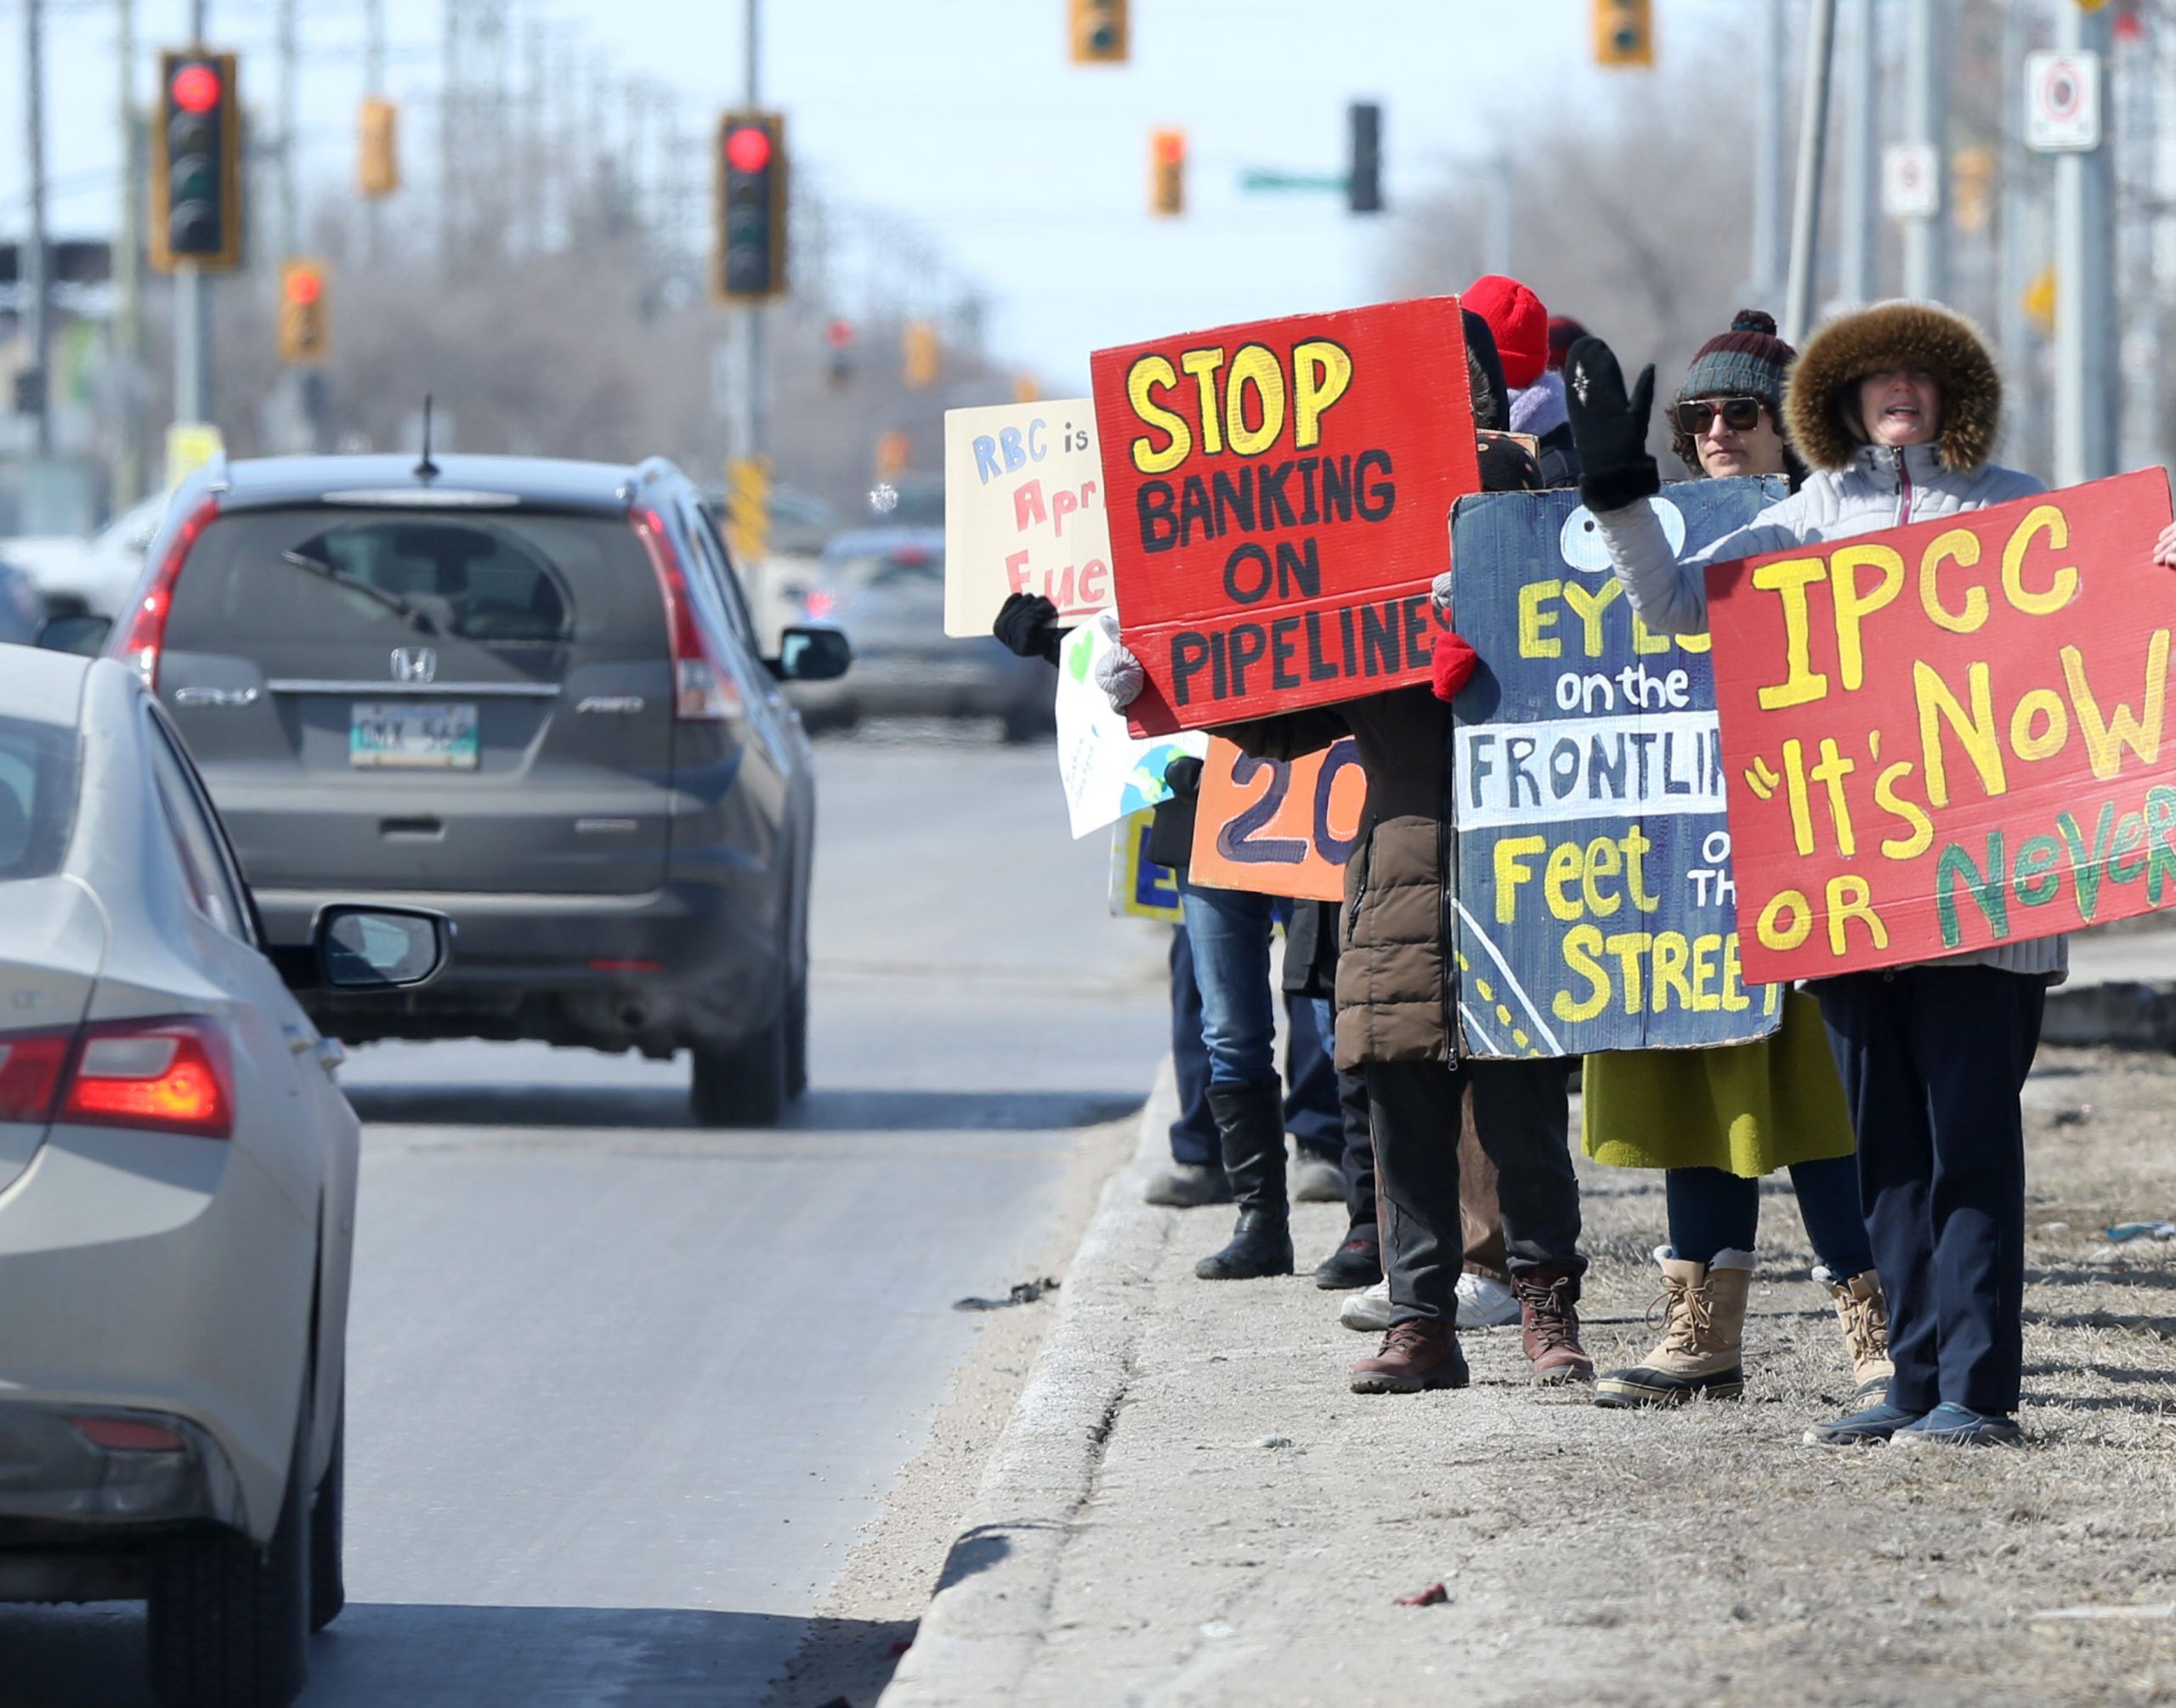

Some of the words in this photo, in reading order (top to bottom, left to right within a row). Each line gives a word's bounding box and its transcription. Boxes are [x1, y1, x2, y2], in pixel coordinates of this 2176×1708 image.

[1125, 337, 1354, 474] STOP
[972, 417, 1048, 485] RBC
[1064, 421, 1089, 453] is
[1013, 478, 1106, 538] Apr
[1136, 449, 1396, 553] BANKING
[1005, 549, 1108, 609] Fue
[1222, 537, 1321, 605] ON
[1752, 504, 2079, 711] IPCC
[1518, 578, 1712, 658] EY
[1556, 672, 1613, 712] on
[1616, 662, 1689, 709] the
[1493, 825, 1660, 924] Feet
[1687, 868, 1737, 907] TH
[1756, 874, 1889, 956] OR
[1552, 923, 1778, 1021] STREE
